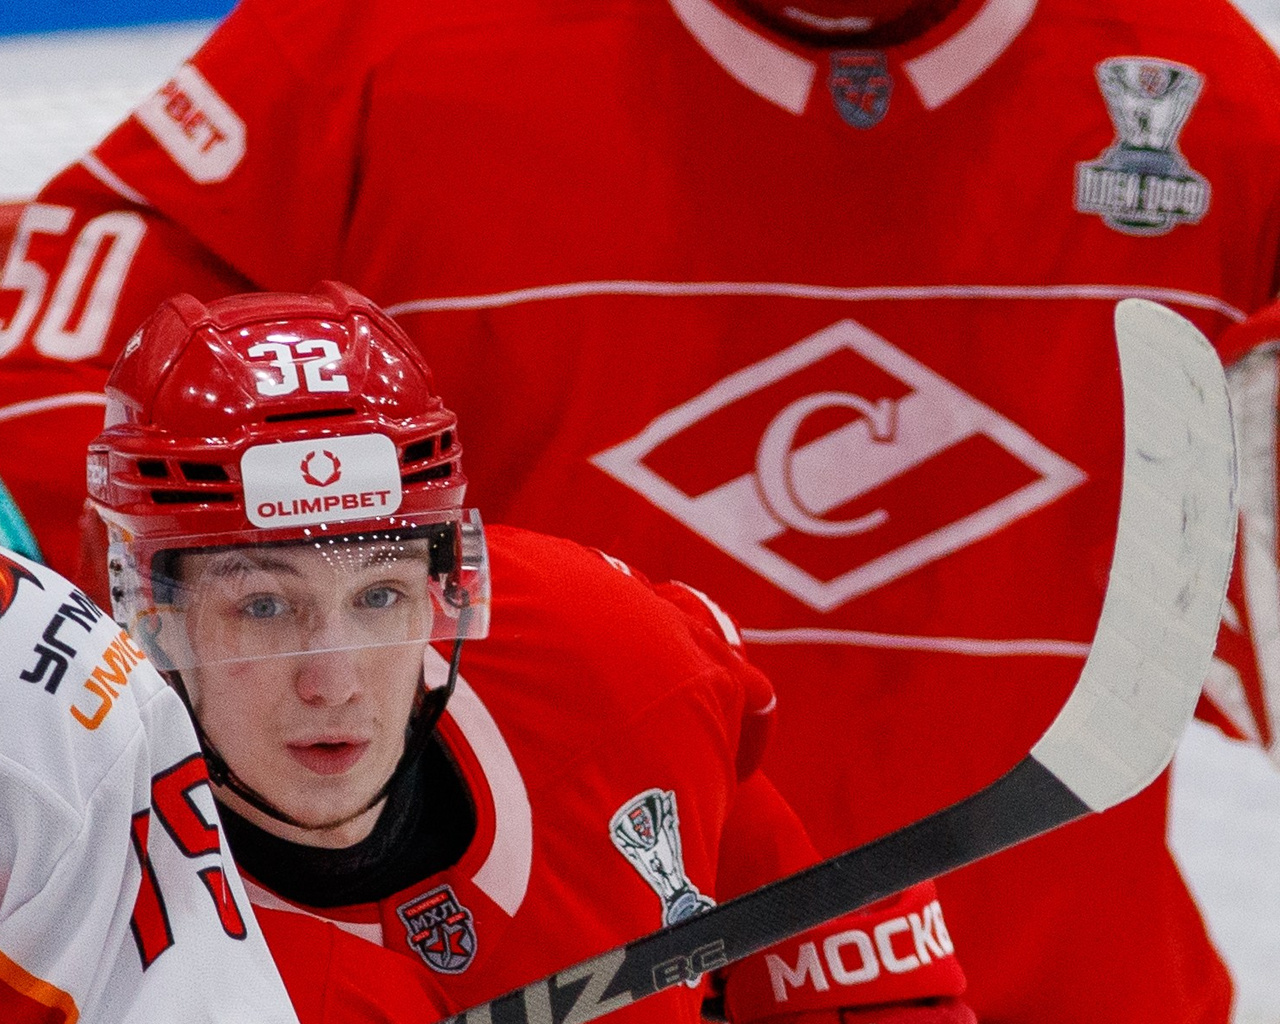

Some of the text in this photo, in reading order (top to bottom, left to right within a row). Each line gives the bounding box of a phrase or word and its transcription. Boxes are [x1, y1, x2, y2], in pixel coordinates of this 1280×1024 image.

[248, 339, 350, 396] 32
[257, 490, 391, 519] OLIMPBET
[19, 589, 103, 695] УГМ
[410, 901, 457, 934] МХЛ
